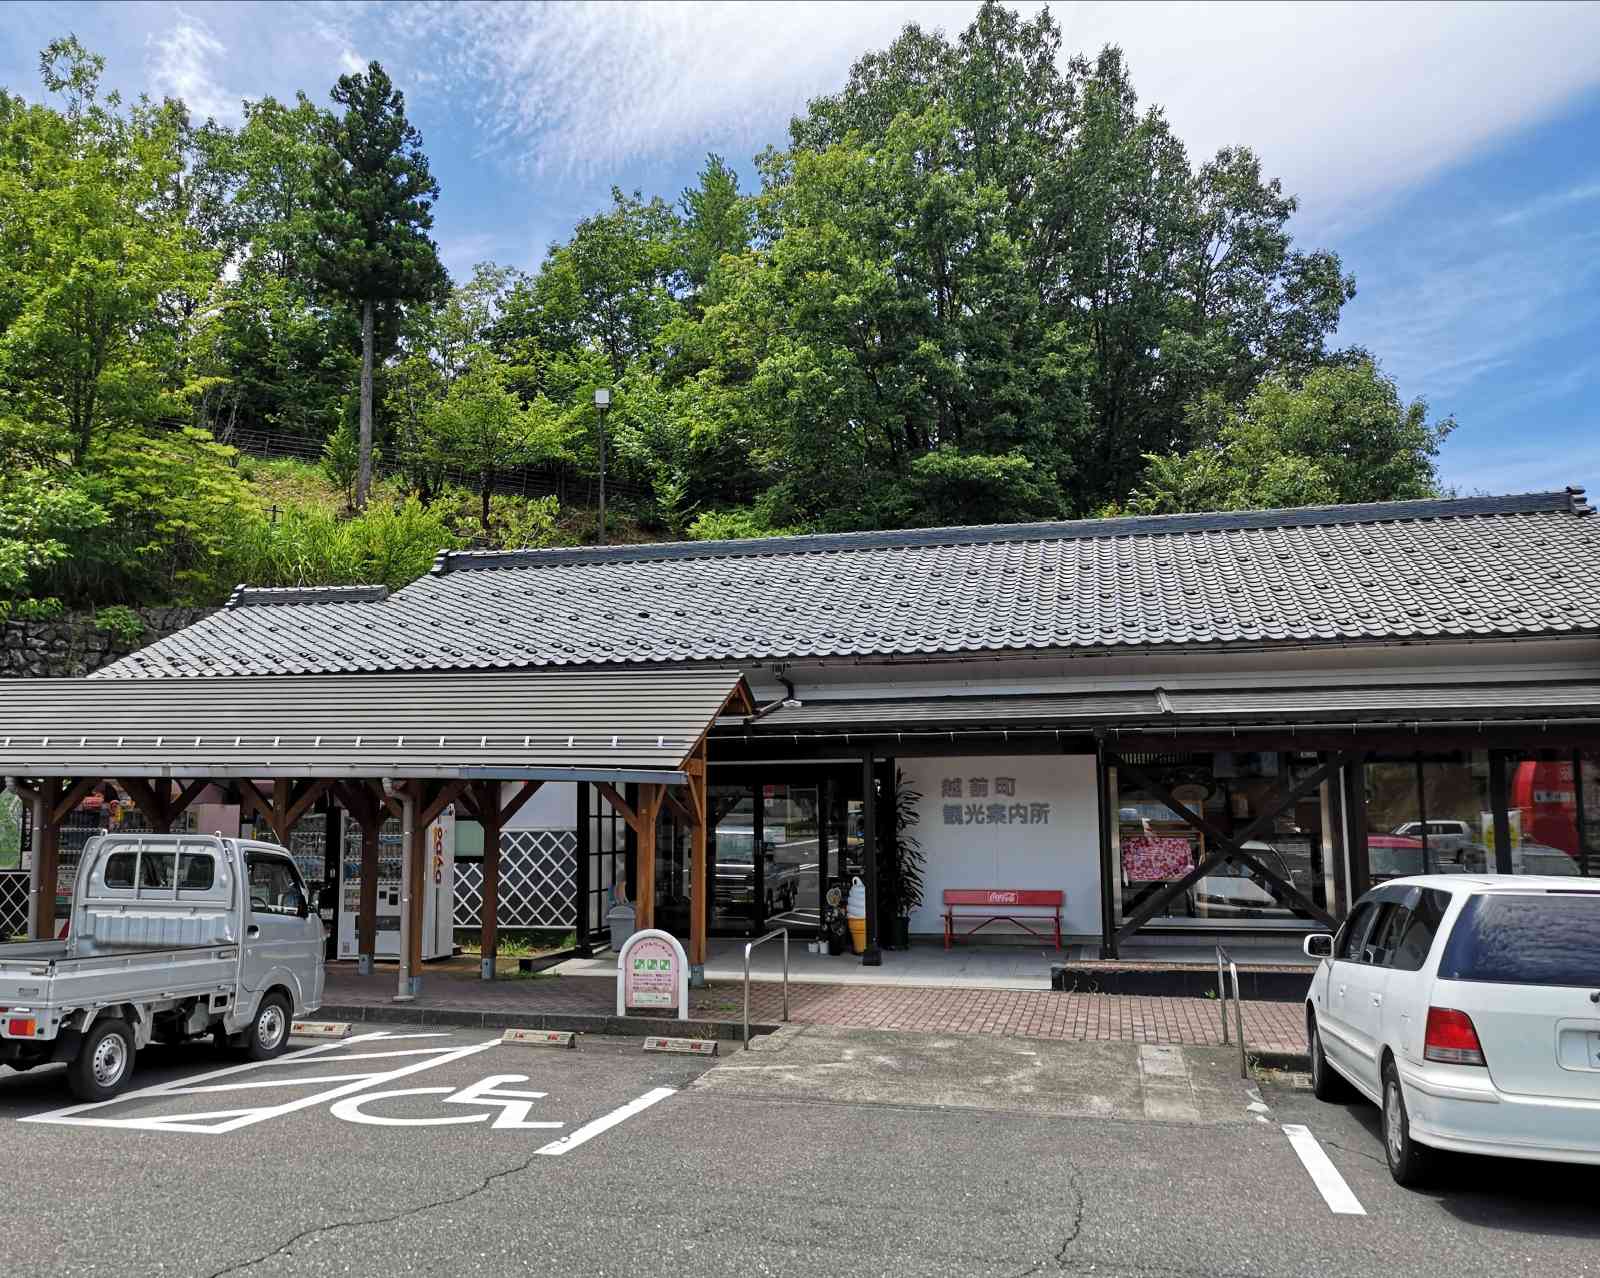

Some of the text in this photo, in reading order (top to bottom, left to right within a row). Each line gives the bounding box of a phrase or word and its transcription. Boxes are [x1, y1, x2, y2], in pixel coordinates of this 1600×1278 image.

[941, 777, 1016, 798] 越前町
[943, 803, 1050, 825] 観光案内所
